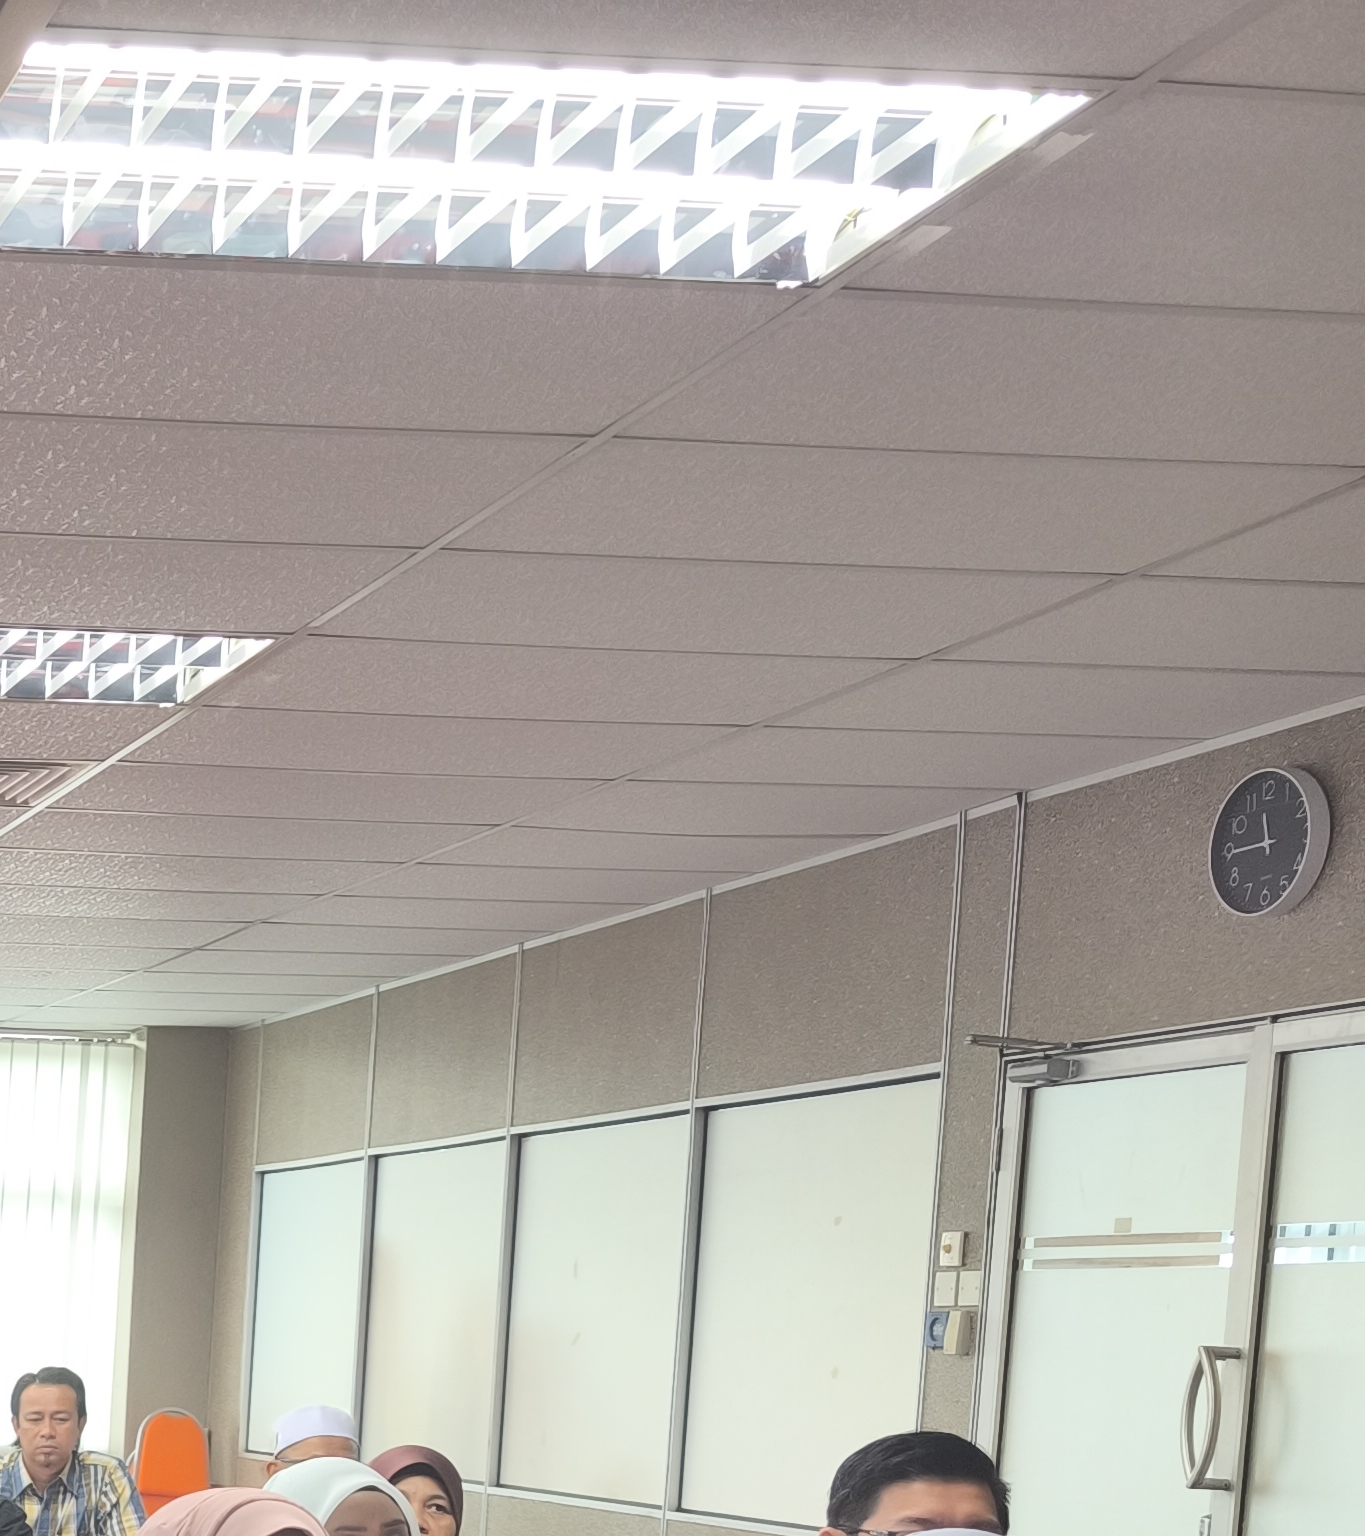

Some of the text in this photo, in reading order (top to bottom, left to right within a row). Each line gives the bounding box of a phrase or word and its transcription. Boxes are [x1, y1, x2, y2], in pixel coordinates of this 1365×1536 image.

[1262, 780, 1275, 800] 12
[1246, 792, 1257, 812] 11
[1231, 815, 1247, 835] 10
[1229, 866, 1239, 886] 8
[1242, 882, 1253, 903] 7
[1259, 885, 1271, 905] 6
